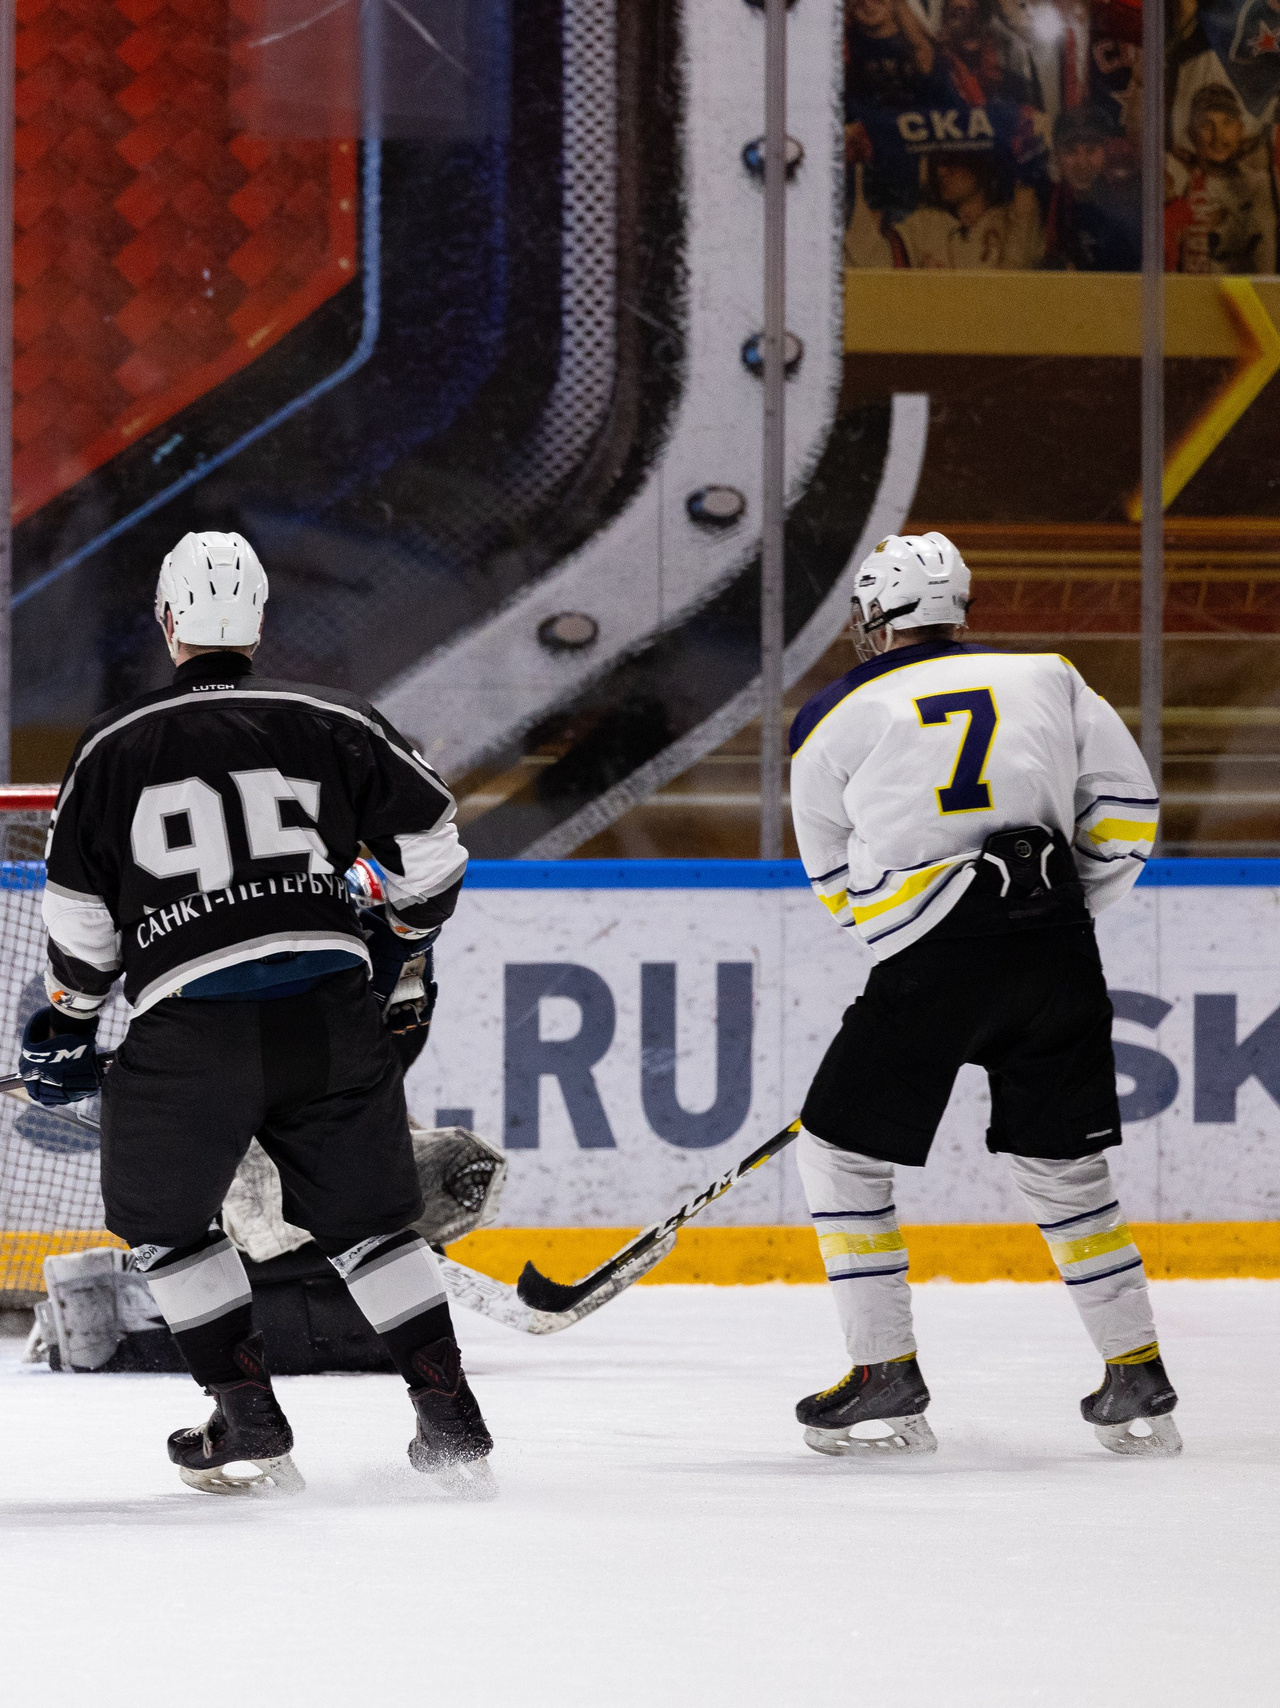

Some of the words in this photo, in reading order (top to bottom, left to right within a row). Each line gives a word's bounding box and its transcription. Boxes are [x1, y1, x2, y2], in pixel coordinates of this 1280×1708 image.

[896, 107, 995, 142] СКА
[192, 684, 235, 692] LUTCH
[912, 686, 1000, 816] 7
[130, 767, 336, 894] 95
